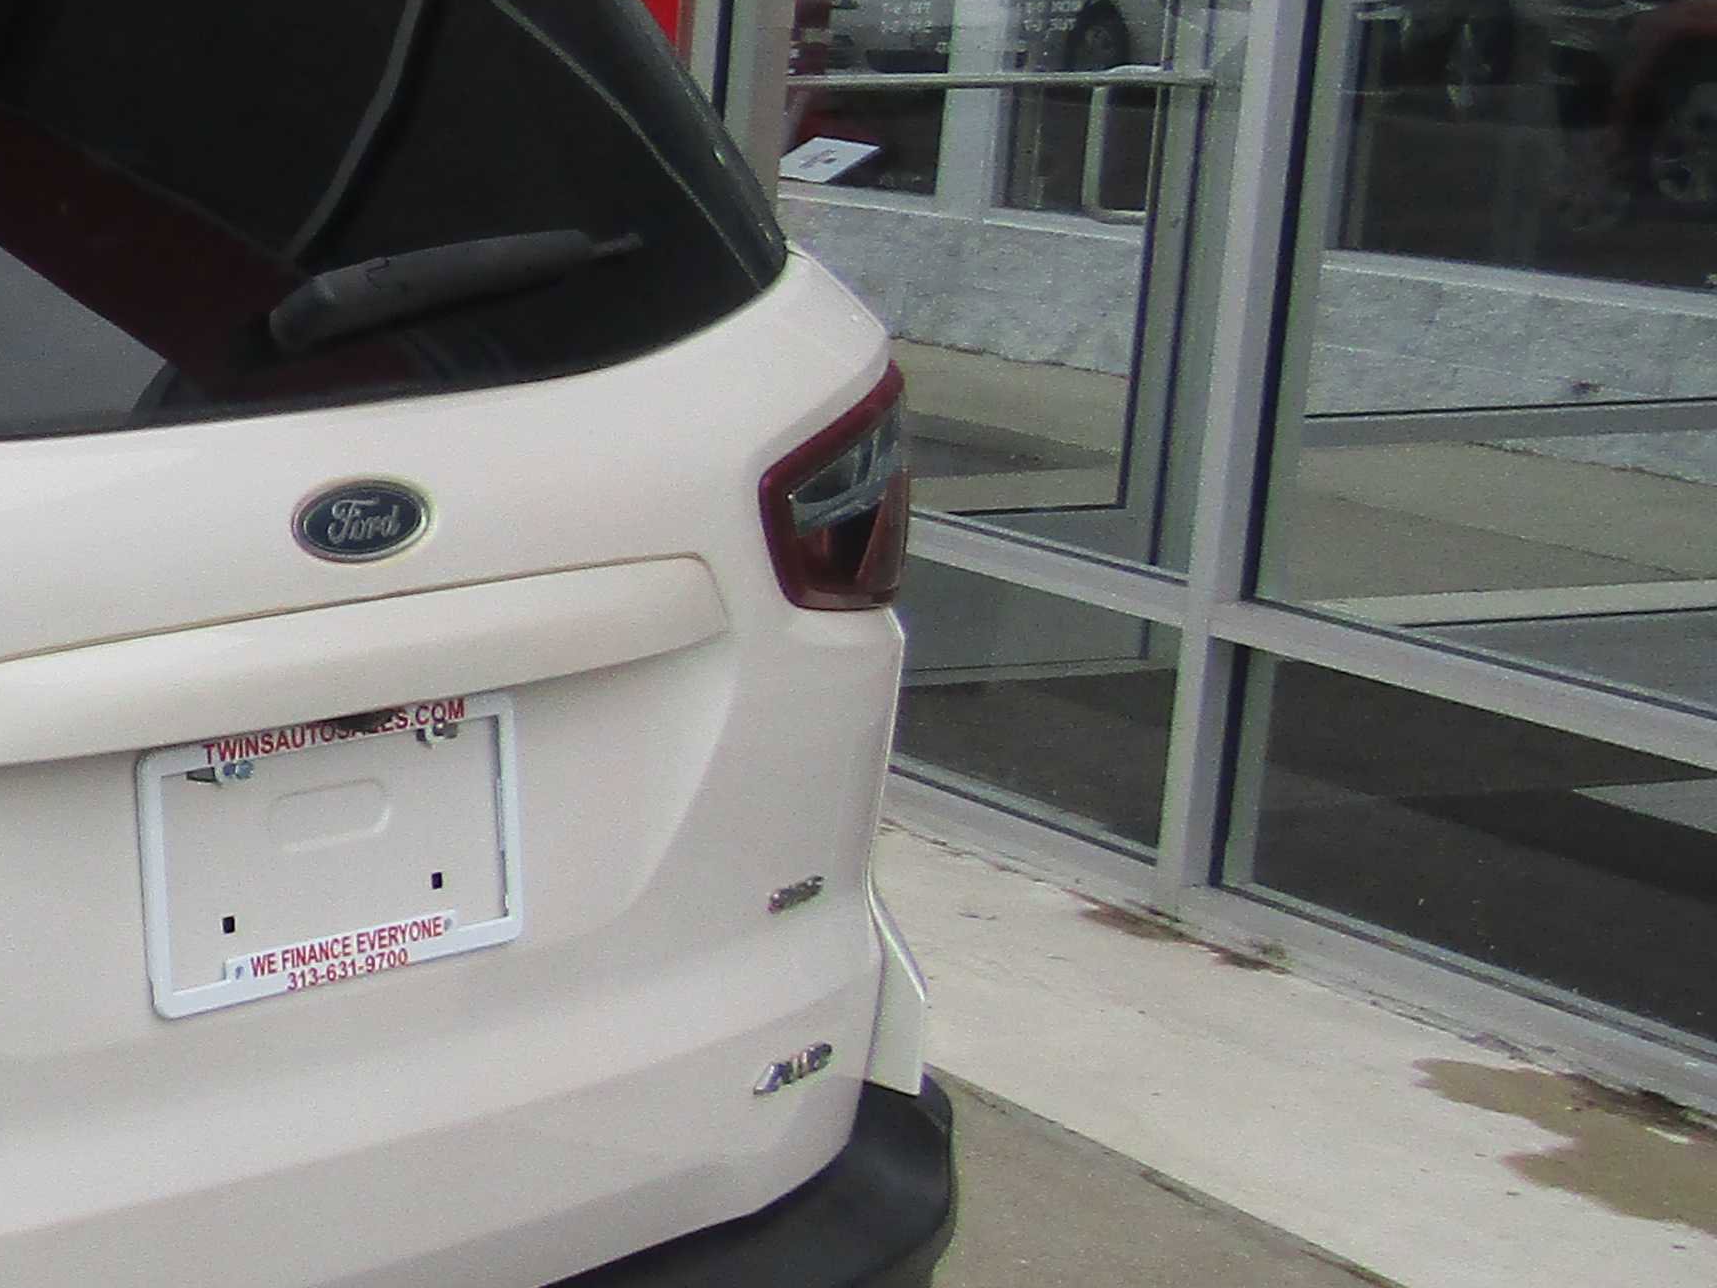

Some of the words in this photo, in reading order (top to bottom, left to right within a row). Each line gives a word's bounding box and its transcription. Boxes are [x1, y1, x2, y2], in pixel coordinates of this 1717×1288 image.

[327, 497, 401, 544] Ford
[202, 698, 465, 765] TWINSAUTOES.COM
[250, 953, 277, 977] WE
[281, 936, 351, 971] FINANCE
[356, 916, 443, 953] EVERYONE
[287, 948, 409, 991] 313-631-9700
